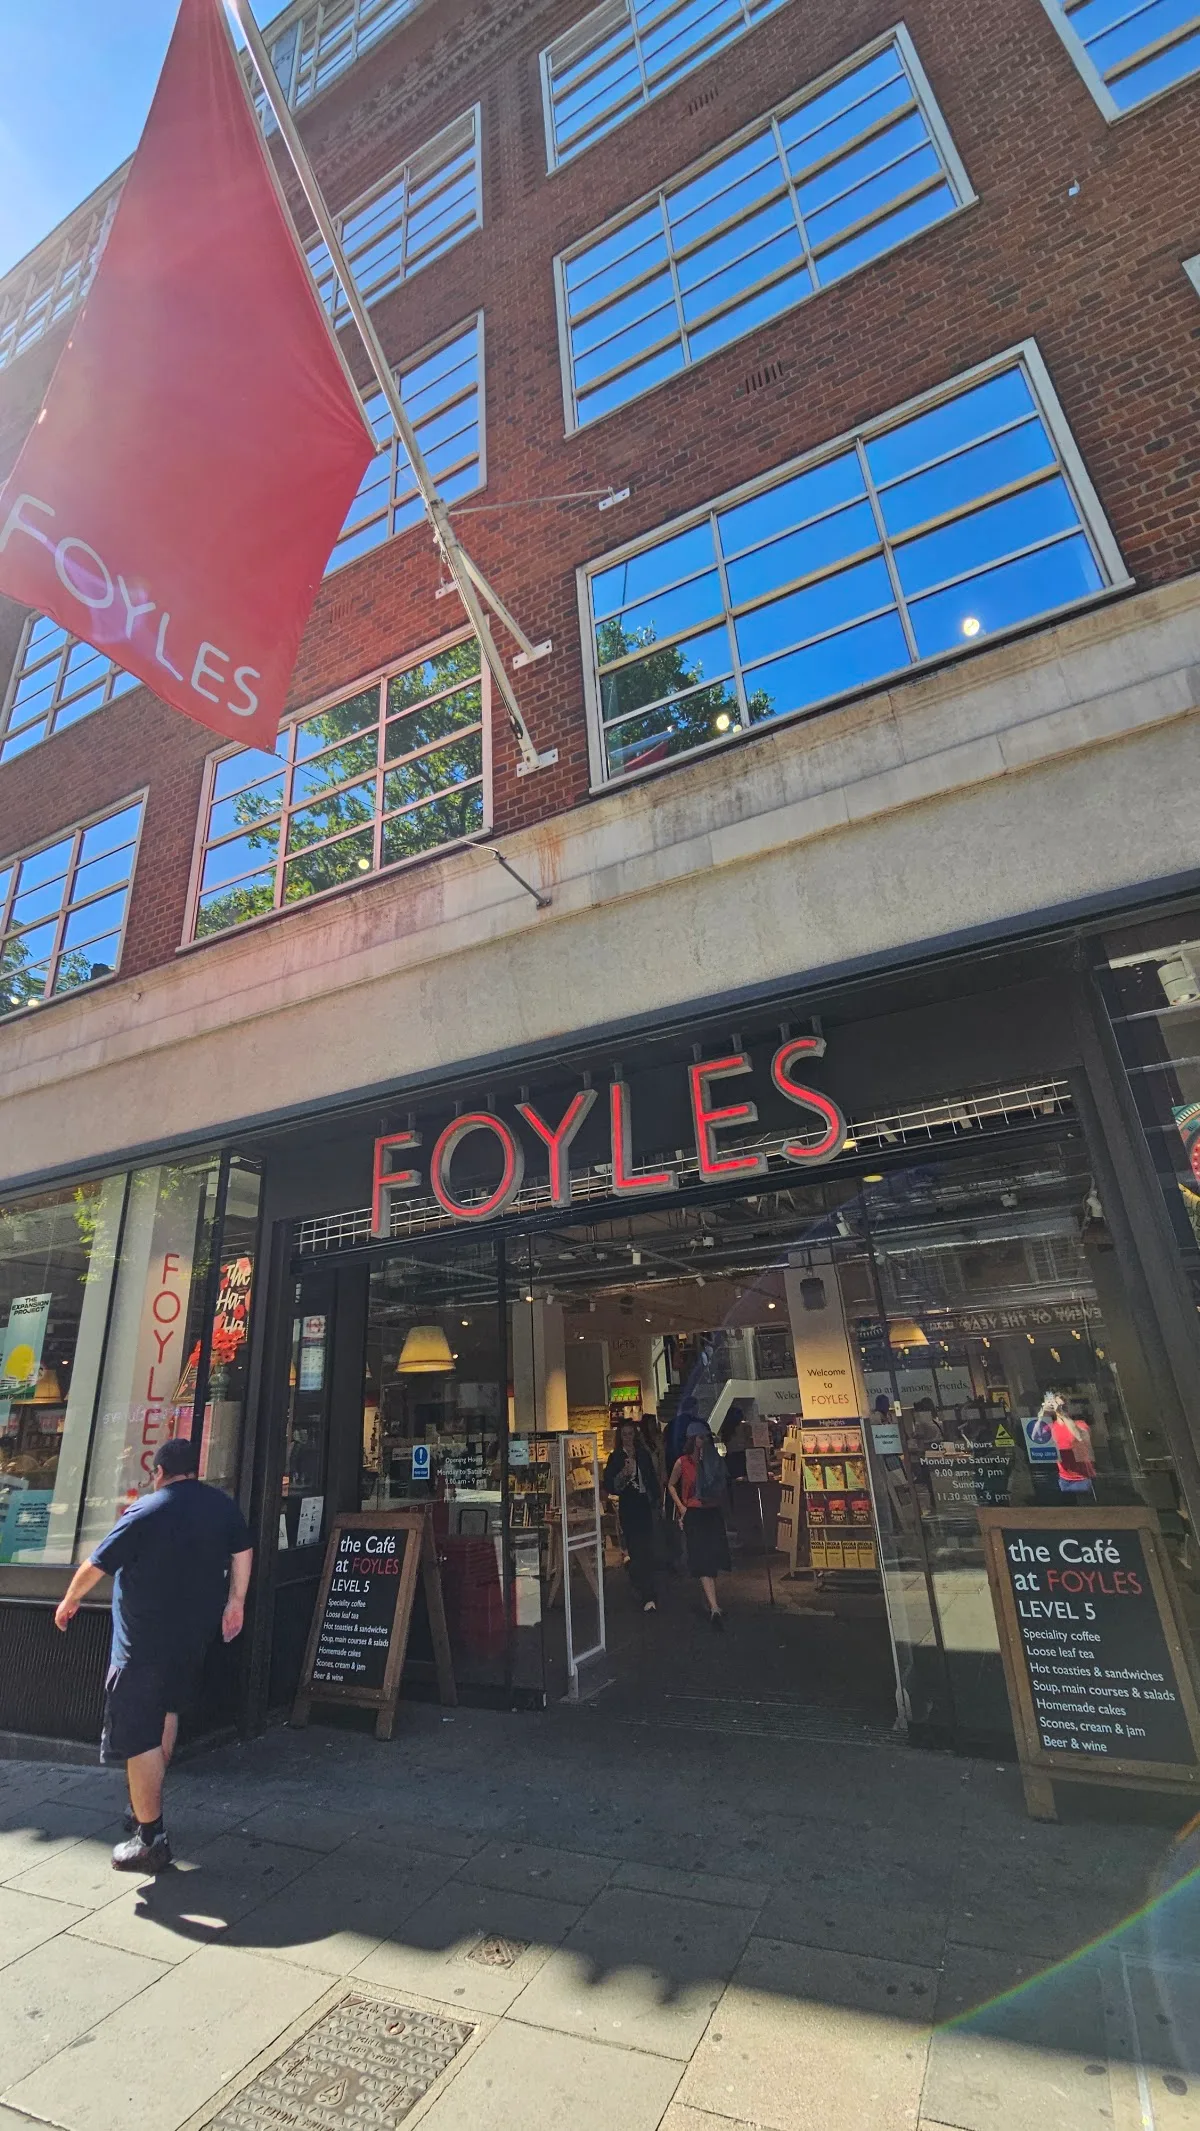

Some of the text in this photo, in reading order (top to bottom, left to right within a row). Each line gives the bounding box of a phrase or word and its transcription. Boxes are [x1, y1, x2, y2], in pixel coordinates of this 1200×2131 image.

[0, 493, 261, 717] FOYLES
[371, 1035, 848, 1239] FOYLES
[11, 1300, 50, 1311] EXPANSION
[13, 1306, 45, 1316] PROJECT
[138, 1253, 181, 1488] FOYLES
[807, 1368, 846, 1376] Welcome
[811, 1394, 850, 1405] FOYLES
[920, 1457, 954, 1466] Monday
[969, 1455, 1010, 1465] Saturday
[437, 1468, 458, 1476] Monday
[467, 1468, 493, 1476] Saturday
[934, 1468, 953, 1477] 9.00
[978, 1467, 984, 1476] 9
[987, 1469, 1003, 1478] pm
[952, 1480, 985, 1490] Sunday
[937, 1492, 960, 1500] 11.30
[986, 1492, 992, 1500] 6
[995, 1493, 1010, 1502] pm
[340, 1535, 396, 1554] the Café
[1008, 1538, 1121, 1564] the Café
[336, 1558, 399, 1575] at FOYLES
[331, 1578, 370, 1593] LEVEL 5
[1014, 1569, 1143, 1595] at FOYLES
[328, 1598, 366, 1608] Speciality coffee
[1019, 1600, 1097, 1620] LEVEL 5
[326, 1610, 340, 1619] Loose
[341, 1611, 351, 1619] leaf
[323, 1622, 388, 1634] Hot toasties & sandwiches
[321, 1633, 334, 1643] Soup,
[347, 1637, 367, 1645] courses
[373, 1639, 389, 1647] salads
[1023, 1628, 1101, 1643] Speciality coffee
[318, 1646, 361, 1658] Homemade cakes
[1026, 1644, 1095, 1659] Loose leaf tea
[316, 1658, 334, 1668] Scones,
[335, 1661, 350, 1669] cream
[356, 1663, 366, 1672] jam
[1029, 1662, 1164, 1682] Hot toasties & sandwiches
[313, 1671, 344, 1682] Beer & wine
[1033, 1680, 1176, 1701] Soup, main courses & salads
[1036, 1698, 1127, 1716] Homemade cakes
[1039, 1716, 1146, 1738] Scones, cream & jam
[1043, 1735, 1108, 1752] Beer & wine
